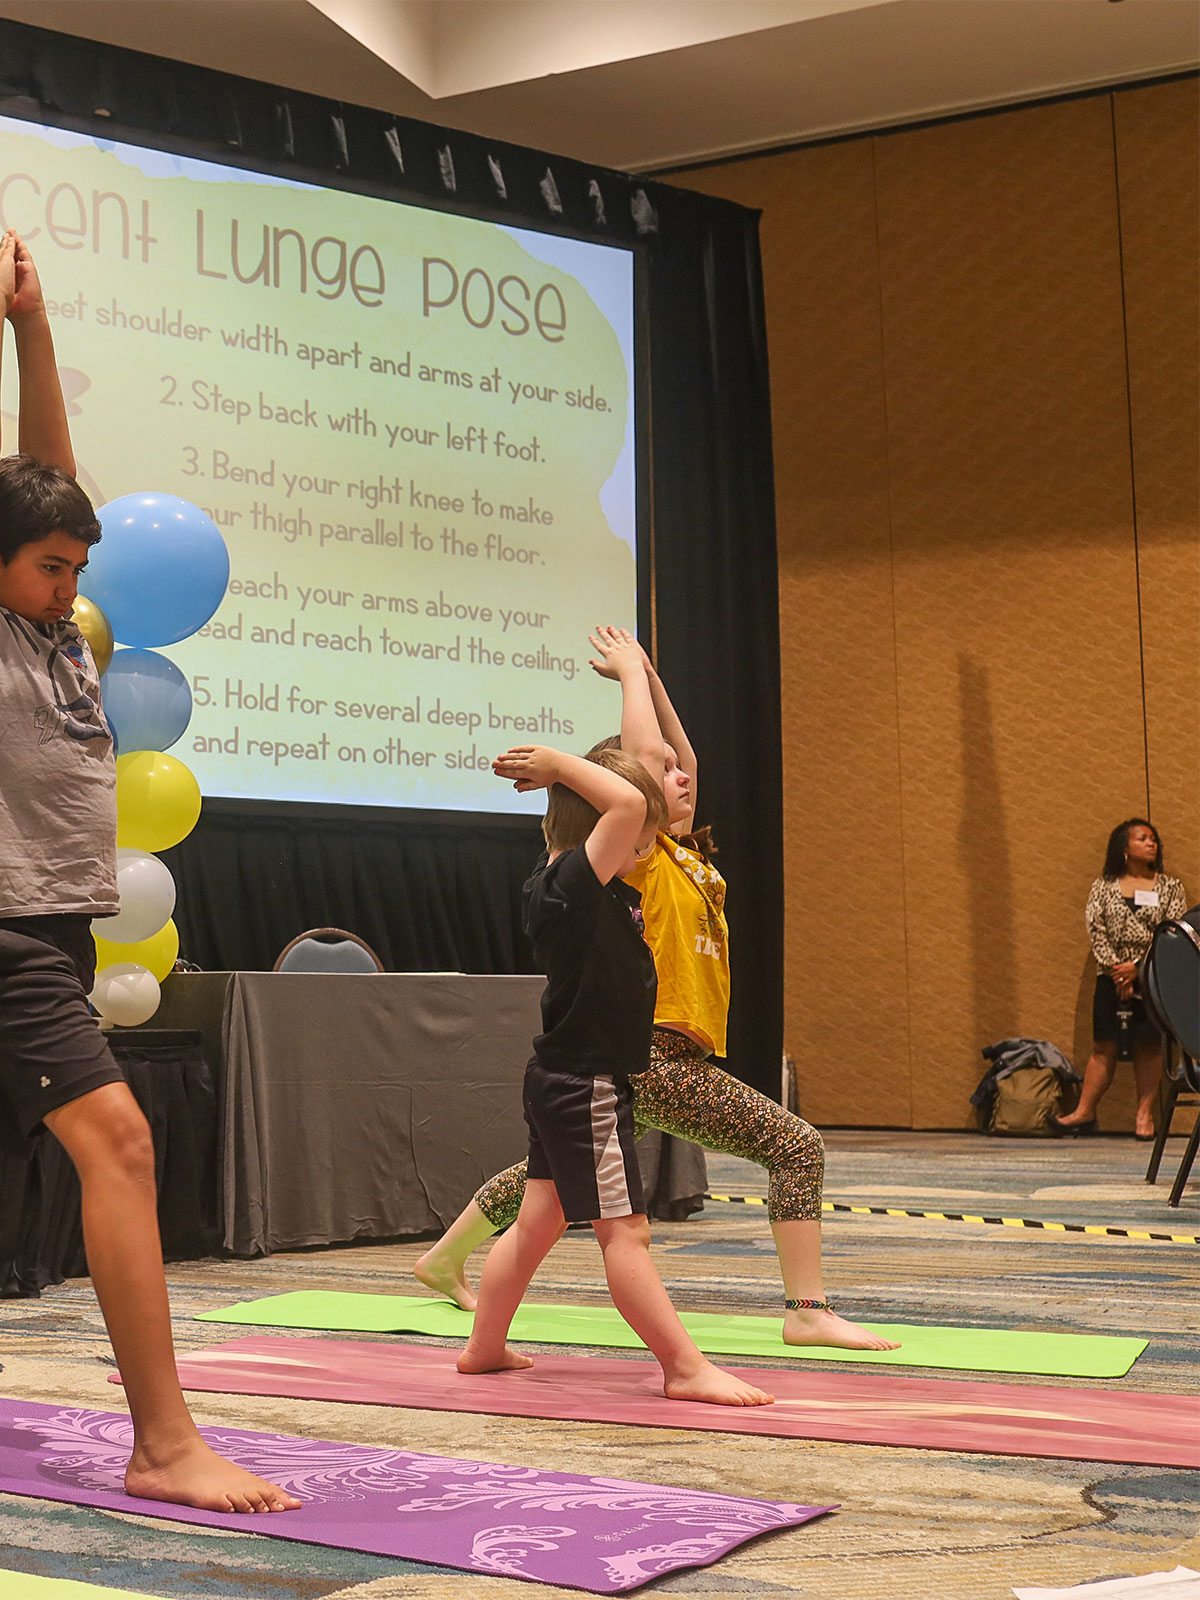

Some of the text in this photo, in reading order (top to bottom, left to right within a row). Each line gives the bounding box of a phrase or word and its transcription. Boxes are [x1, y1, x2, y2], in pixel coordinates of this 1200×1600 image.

[197, 210, 385, 307] Lunge
[423, 257, 566, 343] Pose
[47, 292, 87, 321] eet
[96, 299, 211, 341] shoulder
[221, 324, 288, 356] width
[297, 342, 362, 370] apart
[370, 352, 410, 377] and
[418, 365, 473, 388] arms
[480, 368, 501, 393] at
[508, 382, 558, 404] your
[565, 385, 612, 413] side.
[160, 375, 547, 463] 2. Step back with your left foot.
[182, 446, 553, 525] 3. Bend your right knee to make
[250, 502, 312, 543] thigh
[320, 519, 403, 548] parallel
[410, 523, 433, 551] to
[440, 527, 478, 557] the
[484, 533, 547, 566] floor.
[227, 570, 550, 632] each your arms above your
[198, 612, 581, 681] ead and reach toward the ceiling.
[192, 677, 574, 735] 5. Hold for several deep breaths
[193, 727, 239, 754] and
[247, 733, 330, 766] repeat
[338, 747, 366, 763] on
[373, 738, 436, 767] other
